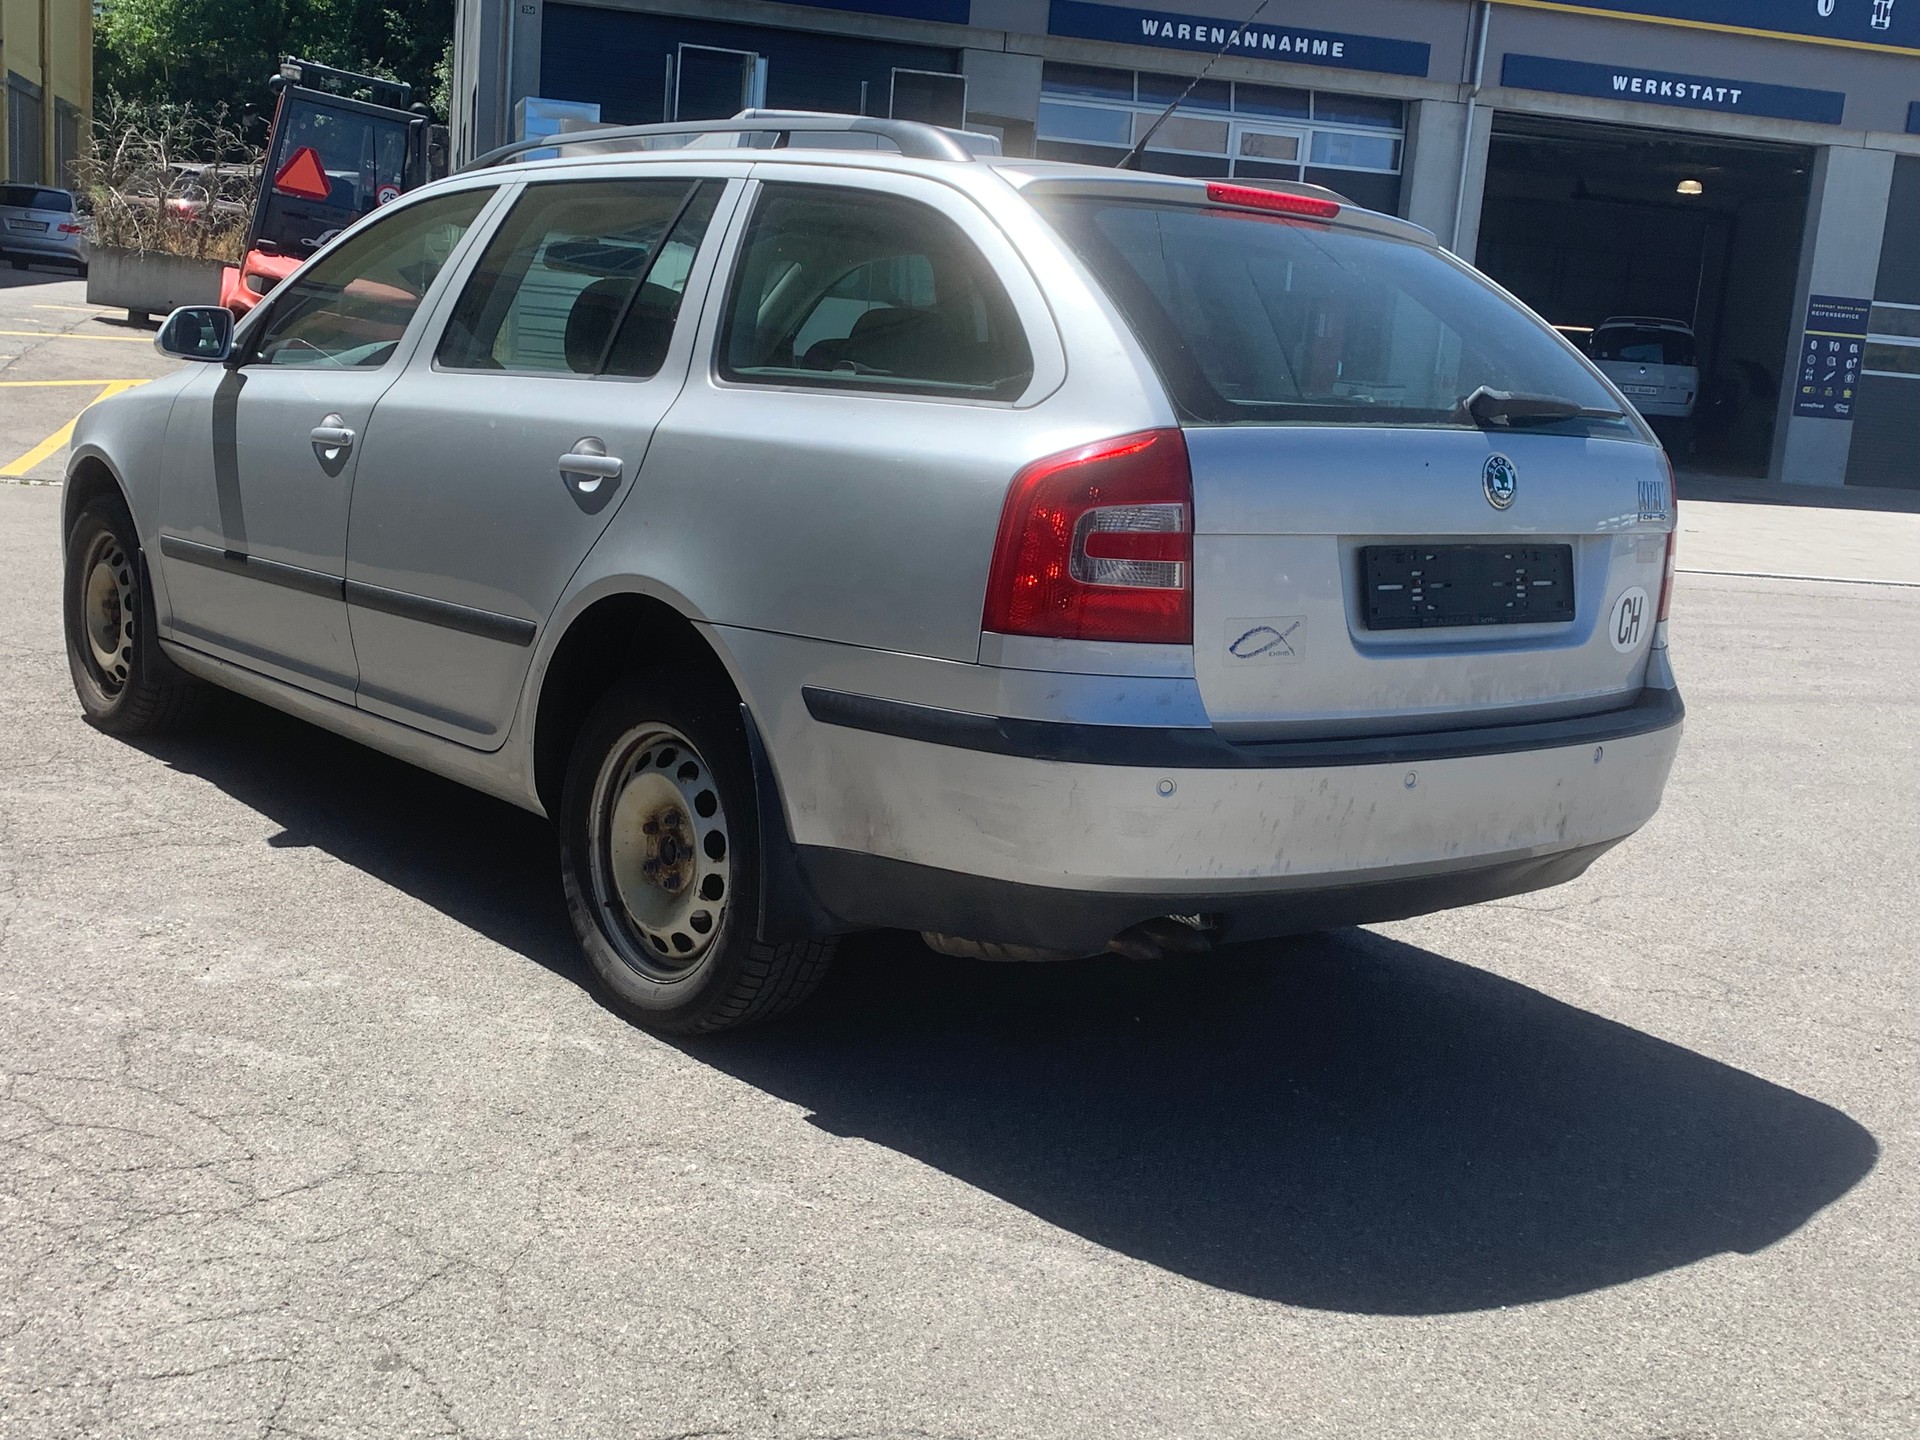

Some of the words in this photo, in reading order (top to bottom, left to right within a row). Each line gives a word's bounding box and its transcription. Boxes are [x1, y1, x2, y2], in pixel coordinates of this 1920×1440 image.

[1141, 18, 1345, 58] WARENANNAHME
[1612, 75, 1742, 104] WERKSTATT
[1617, 596, 1643, 644] CH
